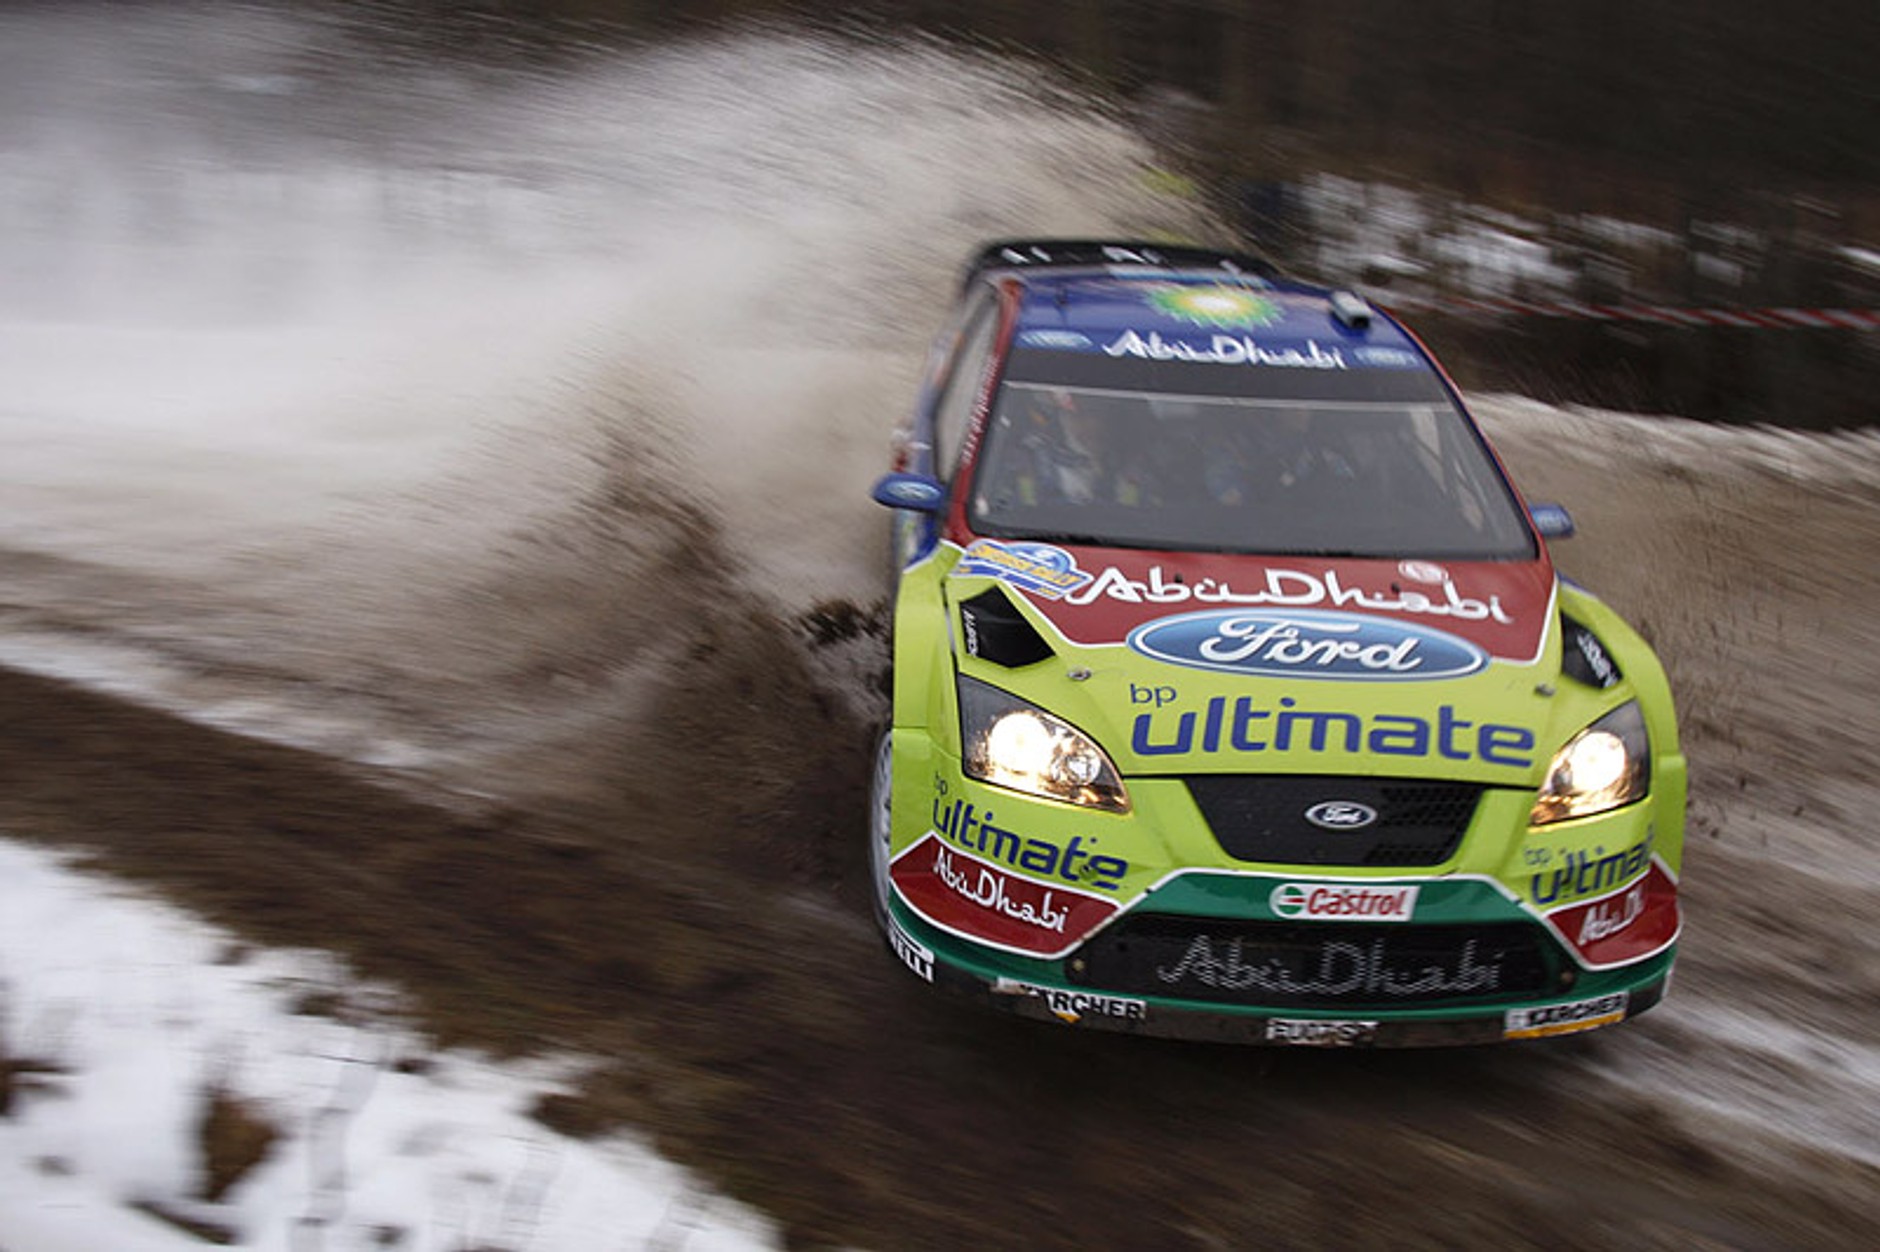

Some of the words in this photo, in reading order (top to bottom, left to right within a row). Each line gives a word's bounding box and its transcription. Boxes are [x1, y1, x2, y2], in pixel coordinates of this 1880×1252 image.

[1199, 615, 1422, 672] Ford
[1129, 683, 1178, 708] bp
[1130, 696, 1536, 768] ultimate
[932, 799, 1129, 892] ultimate
[1307, 887, 1408, 916] Castrol
